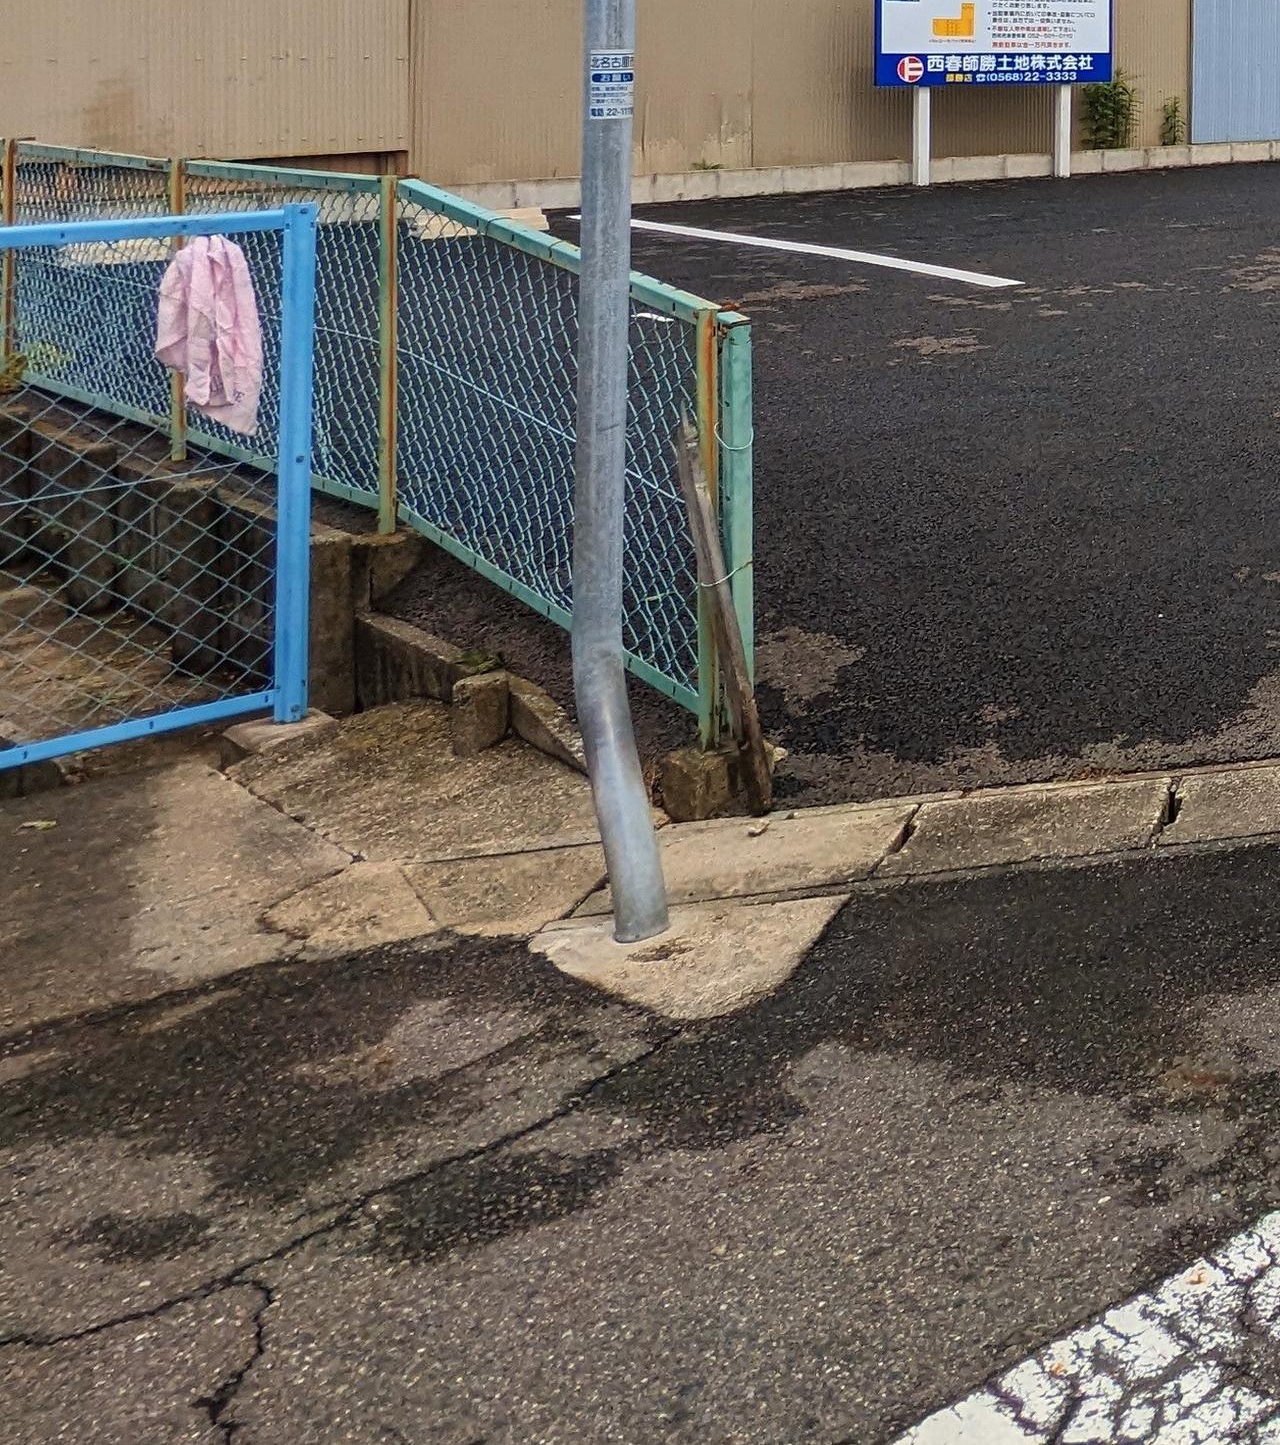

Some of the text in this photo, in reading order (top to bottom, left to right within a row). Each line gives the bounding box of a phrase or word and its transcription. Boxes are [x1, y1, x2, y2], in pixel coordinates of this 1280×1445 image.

[927, 54, 1094, 72] 西春師勝土地株式会社
